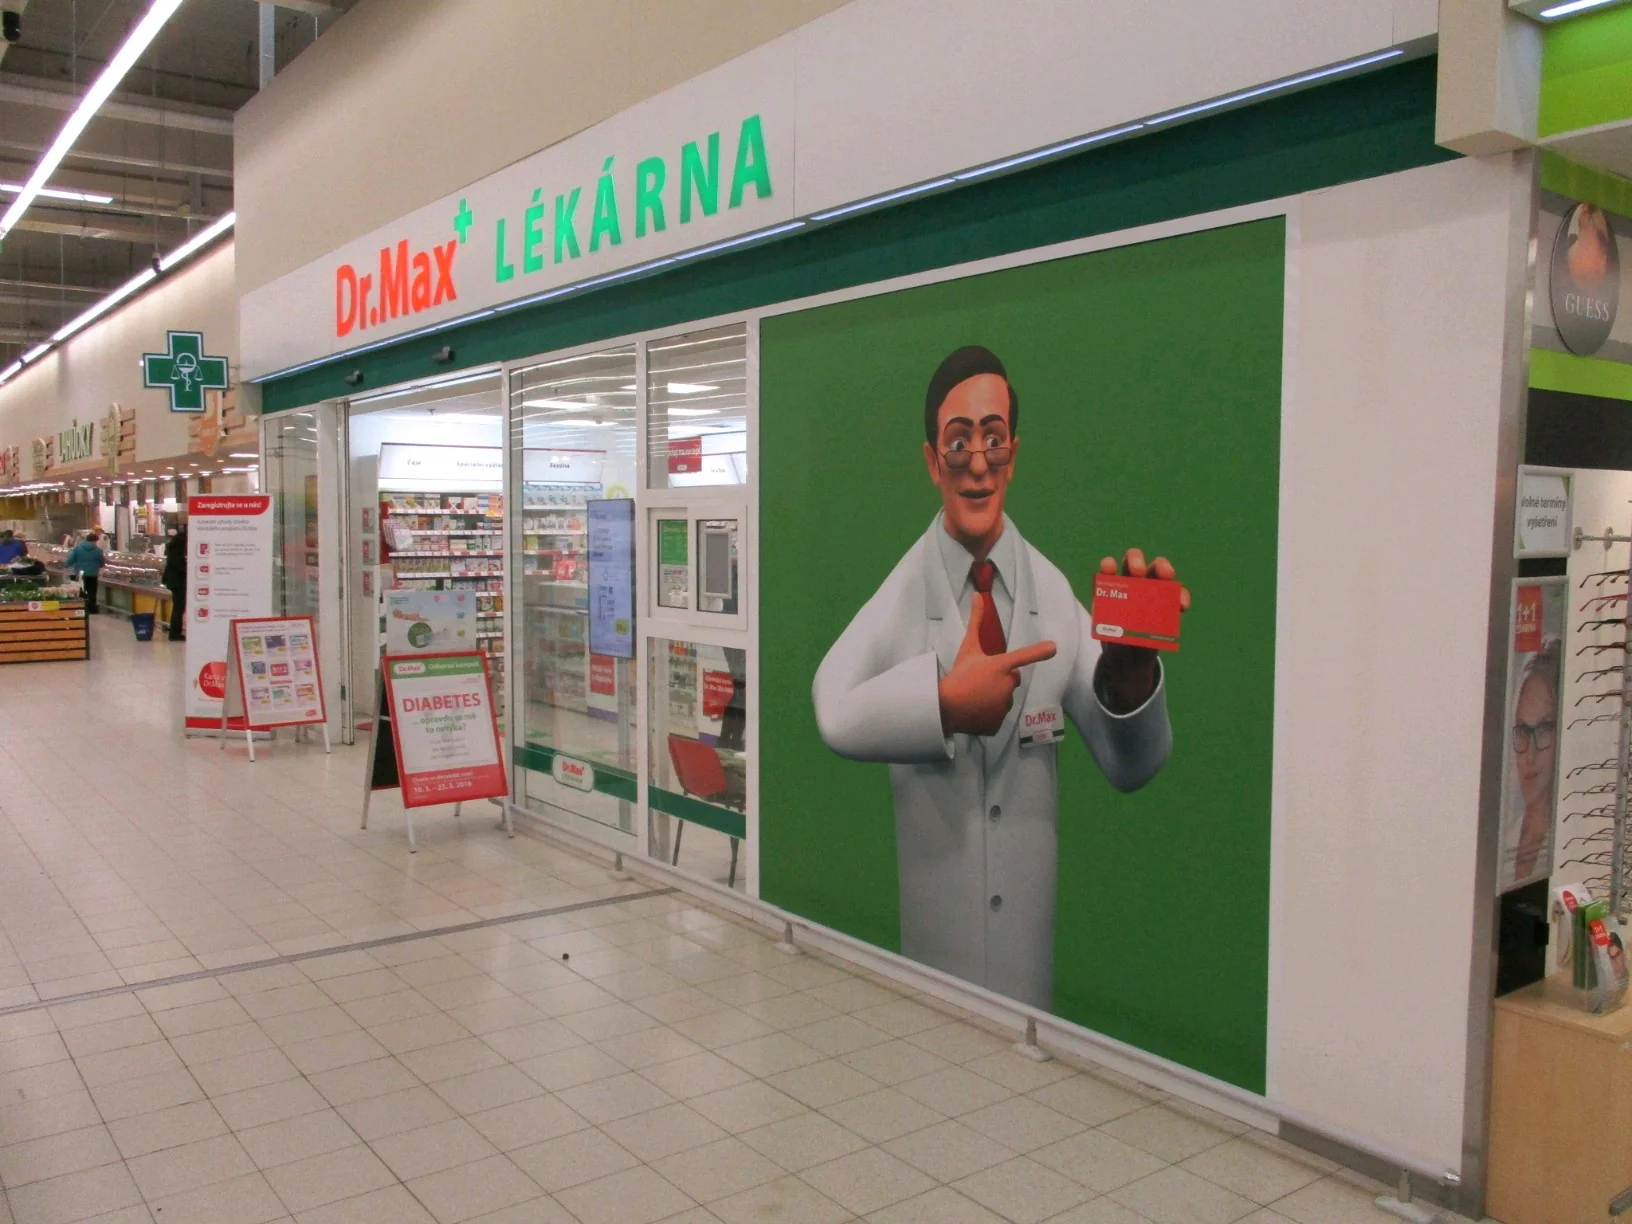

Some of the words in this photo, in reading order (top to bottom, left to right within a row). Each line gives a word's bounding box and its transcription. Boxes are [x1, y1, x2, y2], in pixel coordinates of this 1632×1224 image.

[496, 114, 773, 283] LÉKÁRNA
[336, 239, 457, 338] Dr.Max
[1565, 293, 1609, 322] GUESS
[1096, 588, 1109, 598] Dr.
[1109, 589, 1128, 600] Max
[1517, 602, 1536, 624] 1+1
[402, 692, 482, 713] DIABETES
[420, 713, 454, 726] opravdu
[1024, 711, 1057, 727] Dr.Max
